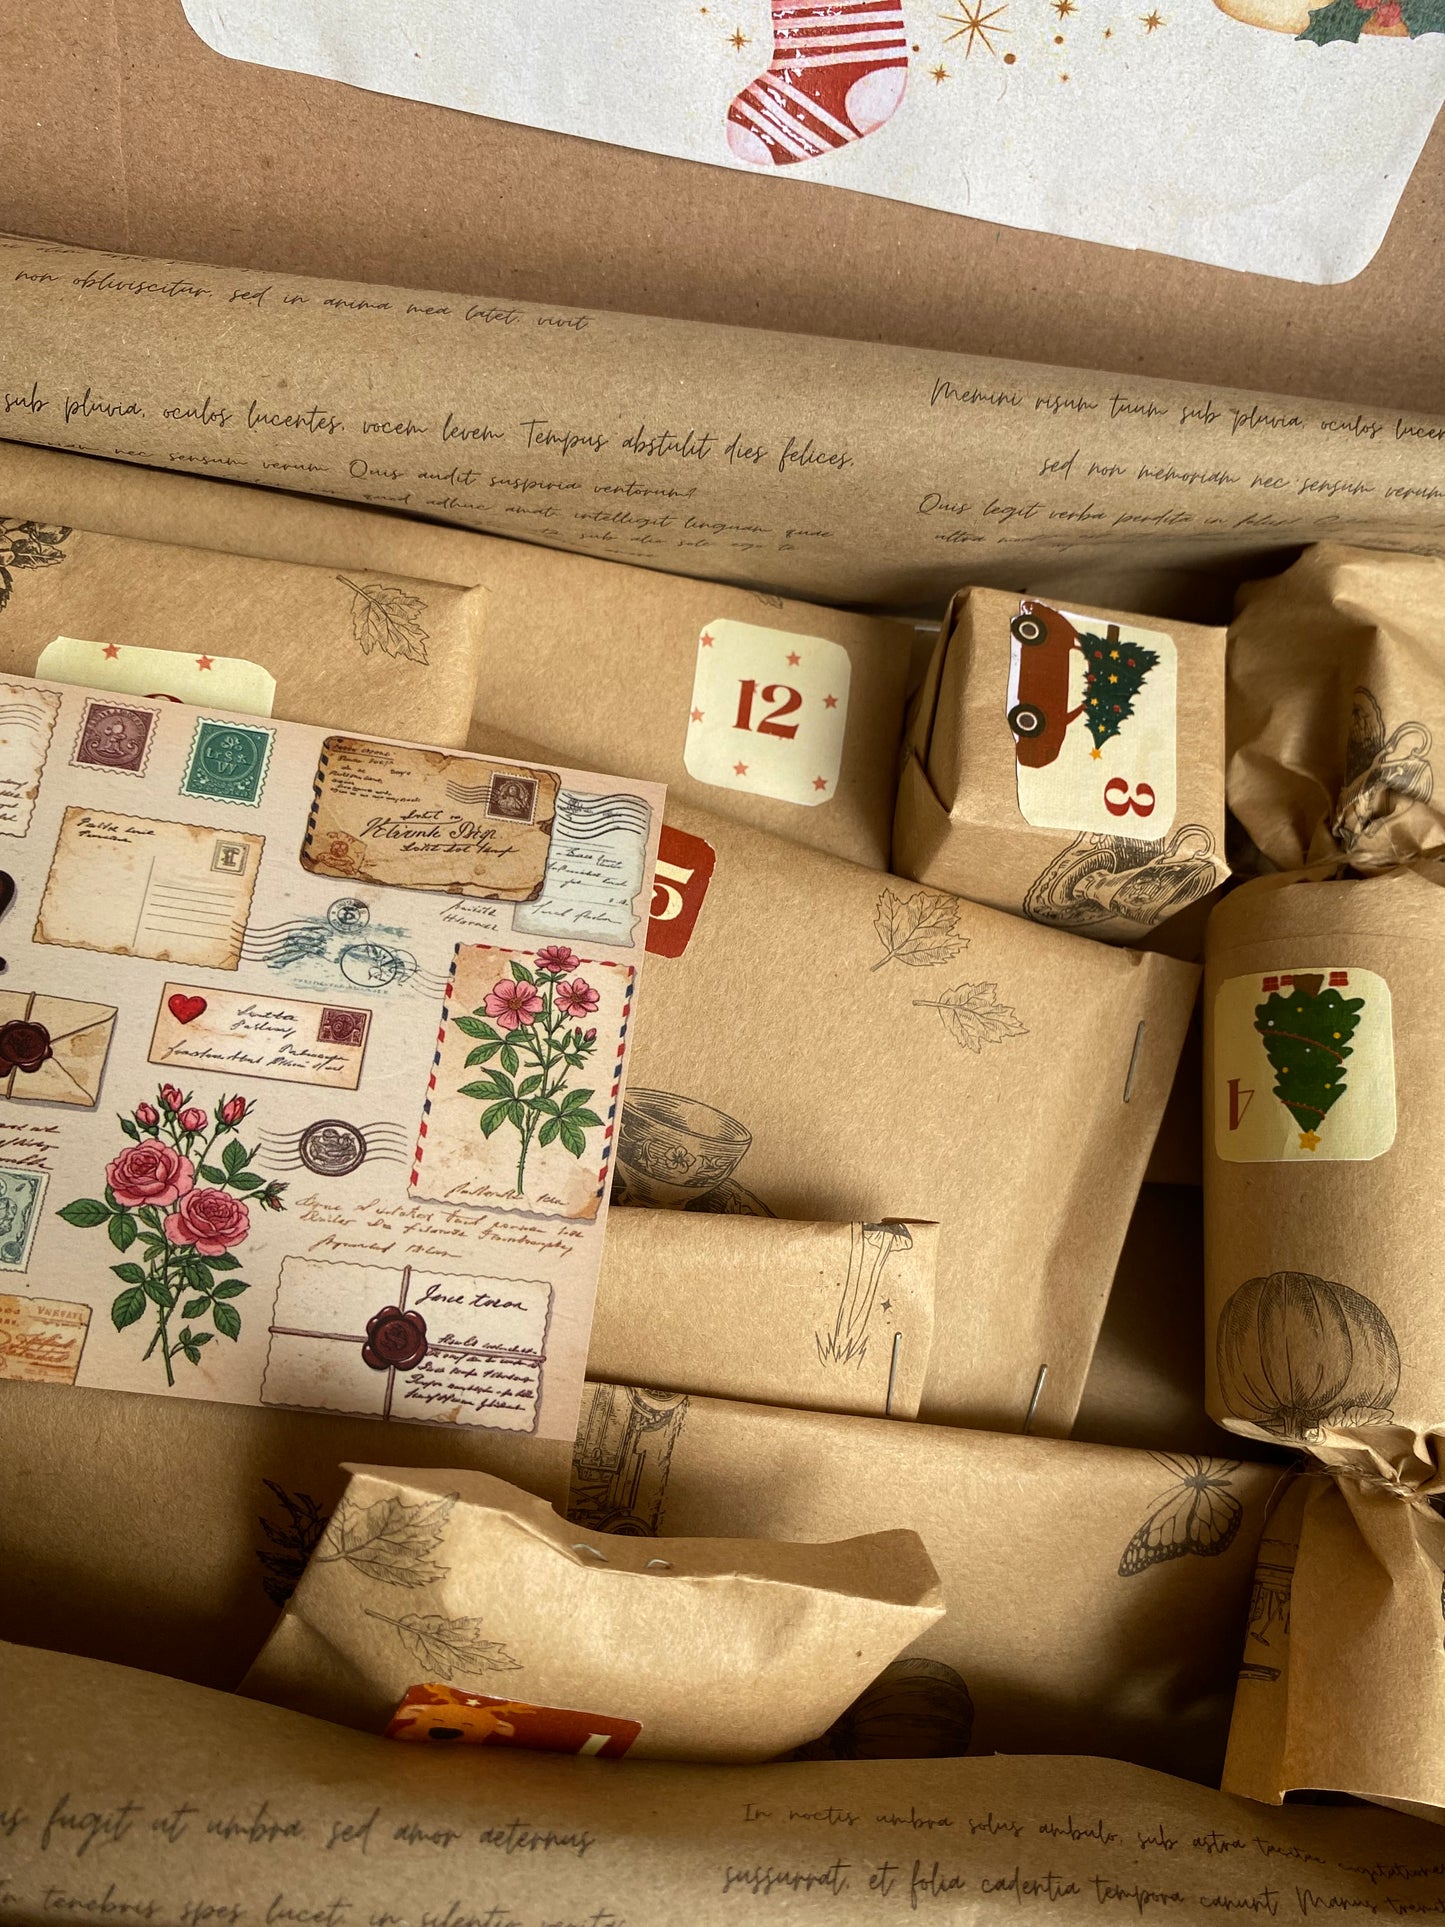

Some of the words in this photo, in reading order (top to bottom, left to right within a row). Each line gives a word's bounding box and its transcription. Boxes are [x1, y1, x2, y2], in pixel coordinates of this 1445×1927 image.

[15, 269, 60, 282] non
[229, 286, 272, 307] sed
[283, 292, 310, 305] in
[2, 381, 49, 414] sub
[163, 396, 233, 428] oculos
[362, 419, 429, 436] vocem
[520, 418, 610, 457] Tempus
[622, 425, 719, 460] abstulit
[724, 432, 768, 465] dies
[930, 377, 1023, 407] Memini
[1035, 394, 1098, 415] risum
[1179, 400, 1221, 425] sub
[1320, 415, 1383, 439] oculos
[349, 458, 404, 481] Quis
[417, 467, 482, 487] audit
[1039, 448, 1080, 480] sed
[1087, 463, 1127, 478] non
[1249, 473, 1291, 489] nec
[916, 492, 972, 517] Quis
[982, 498, 1047, 524] legit
[731, 677, 803, 742] 12
[1103, 777, 1155, 818] 3
[649, 859, 694, 921] 5
[1227, 1078, 1254, 1131] 4
[41, 1792, 145, 1858] fugit
[151, 1802, 200, 1843] ut
[325, 1806, 381, 1855] sed
[393, 1823, 462, 1849] amor
[480, 1816, 597, 1858] aeternus
[743, 1803, 772, 1822] In
[789, 1805, 861, 1826] noctis
[875, 1806, 954, 1829] umbra
[968, 1812, 1025, 1837] solus
[1137, 1824, 1179, 1851] sub
[1192, 1830, 1247, 1854] astra
[180, 1899, 248, 1927] spes
[868, 1860, 900, 1897] et
[909, 1858, 966, 1911] folia
[980, 1866, 1081, 1905] cadentia
[1089, 1874, 1186, 1916] tempora
